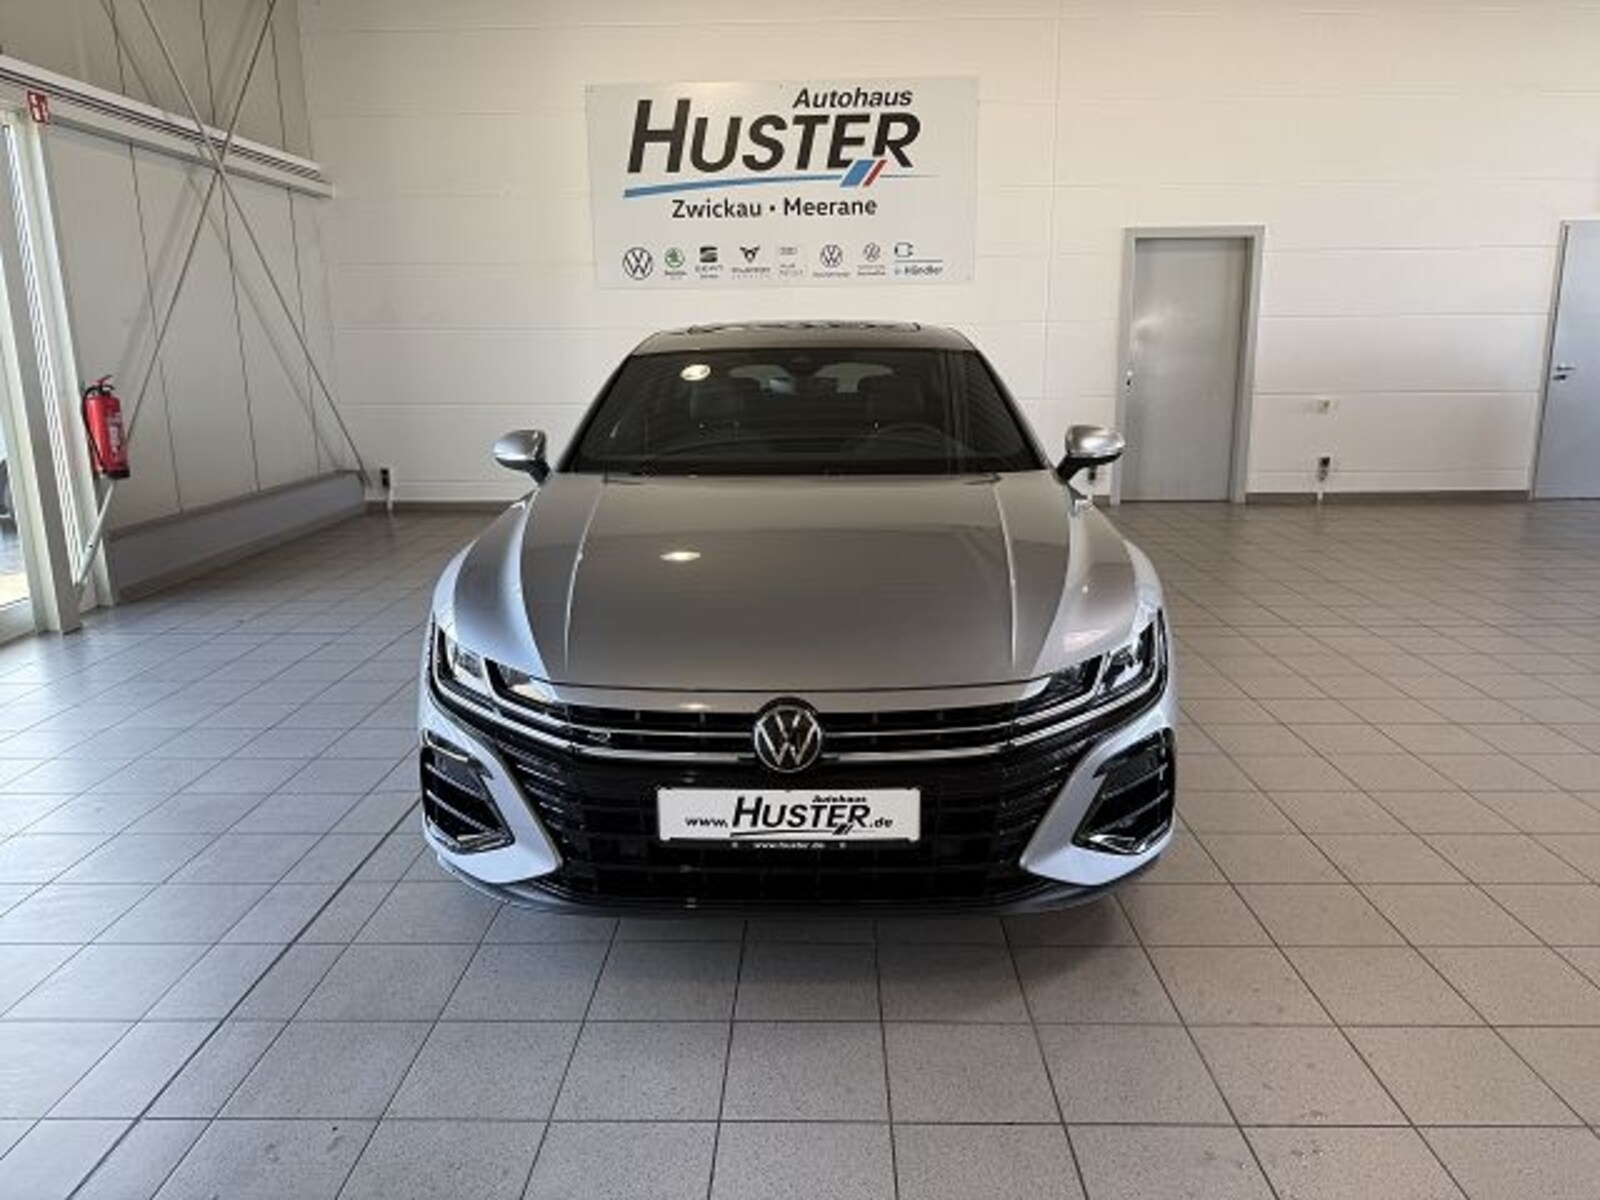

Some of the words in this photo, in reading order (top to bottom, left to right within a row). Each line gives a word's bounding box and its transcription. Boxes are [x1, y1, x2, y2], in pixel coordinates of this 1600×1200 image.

[792, 87, 912, 108] Autohaus
[627, 97, 921, 174] HUSTER
[672, 198, 762, 219] Zwickau
[783, 197, 878, 217] Meerane
